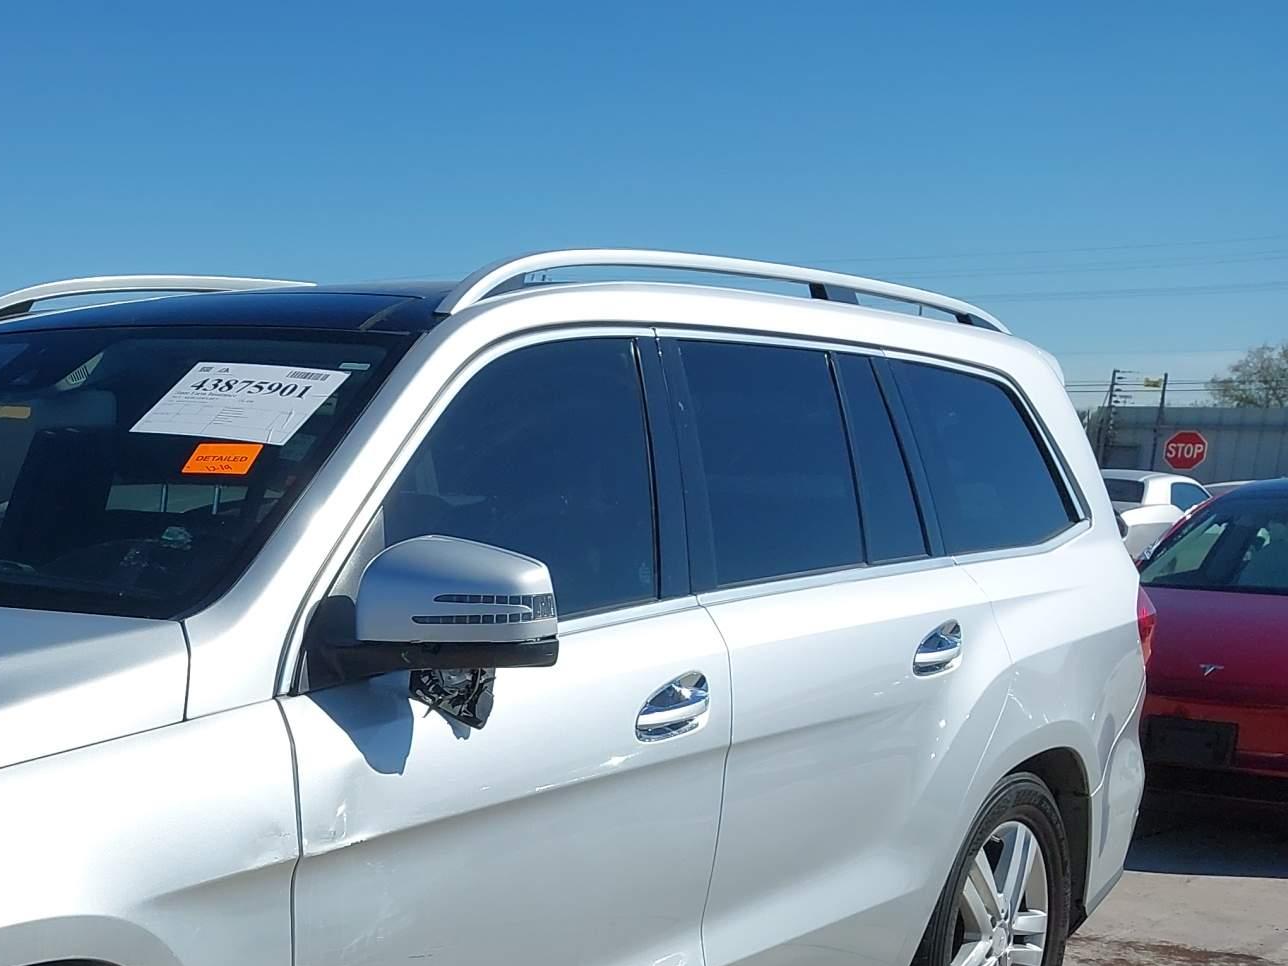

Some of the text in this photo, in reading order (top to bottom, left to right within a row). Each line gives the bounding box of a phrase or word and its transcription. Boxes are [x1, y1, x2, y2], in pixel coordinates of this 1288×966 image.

[190, 377, 312, 399] 43875901
[1166, 443, 1204, 458] STOP
[195, 455, 249, 463] DETAILED
